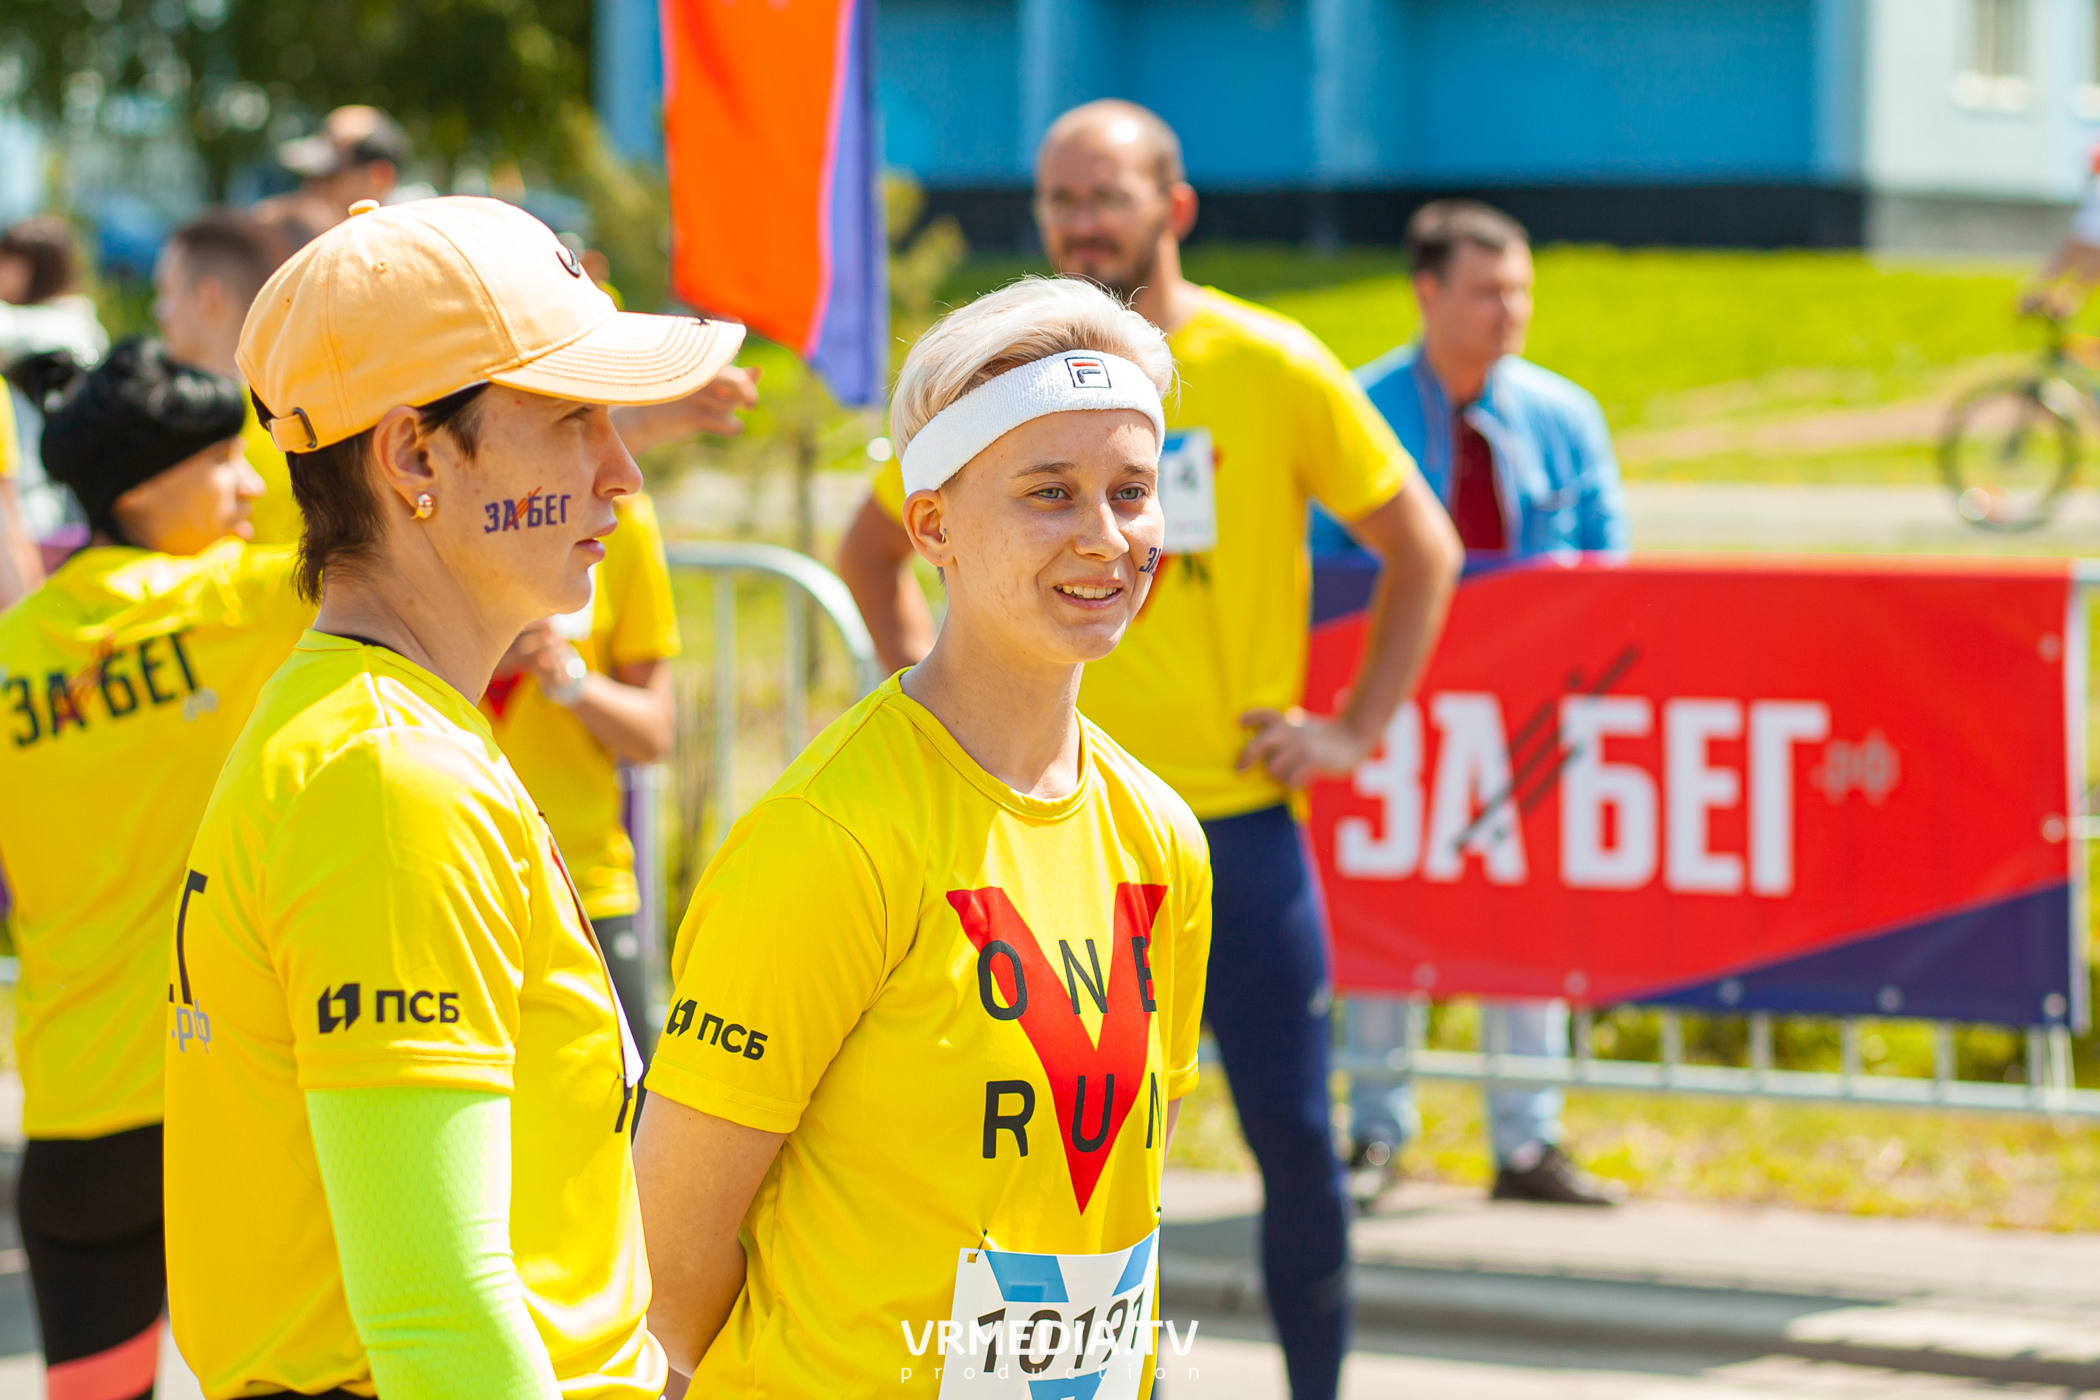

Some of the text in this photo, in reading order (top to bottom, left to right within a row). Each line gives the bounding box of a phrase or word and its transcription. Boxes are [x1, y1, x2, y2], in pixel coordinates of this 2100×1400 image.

[376, 990, 459, 1023] ПСБ
[977, 935, 1157, 1021] ONE
[697, 1012, 769, 1061] ПСБ
[982, 1071, 1164, 1159] RUN
